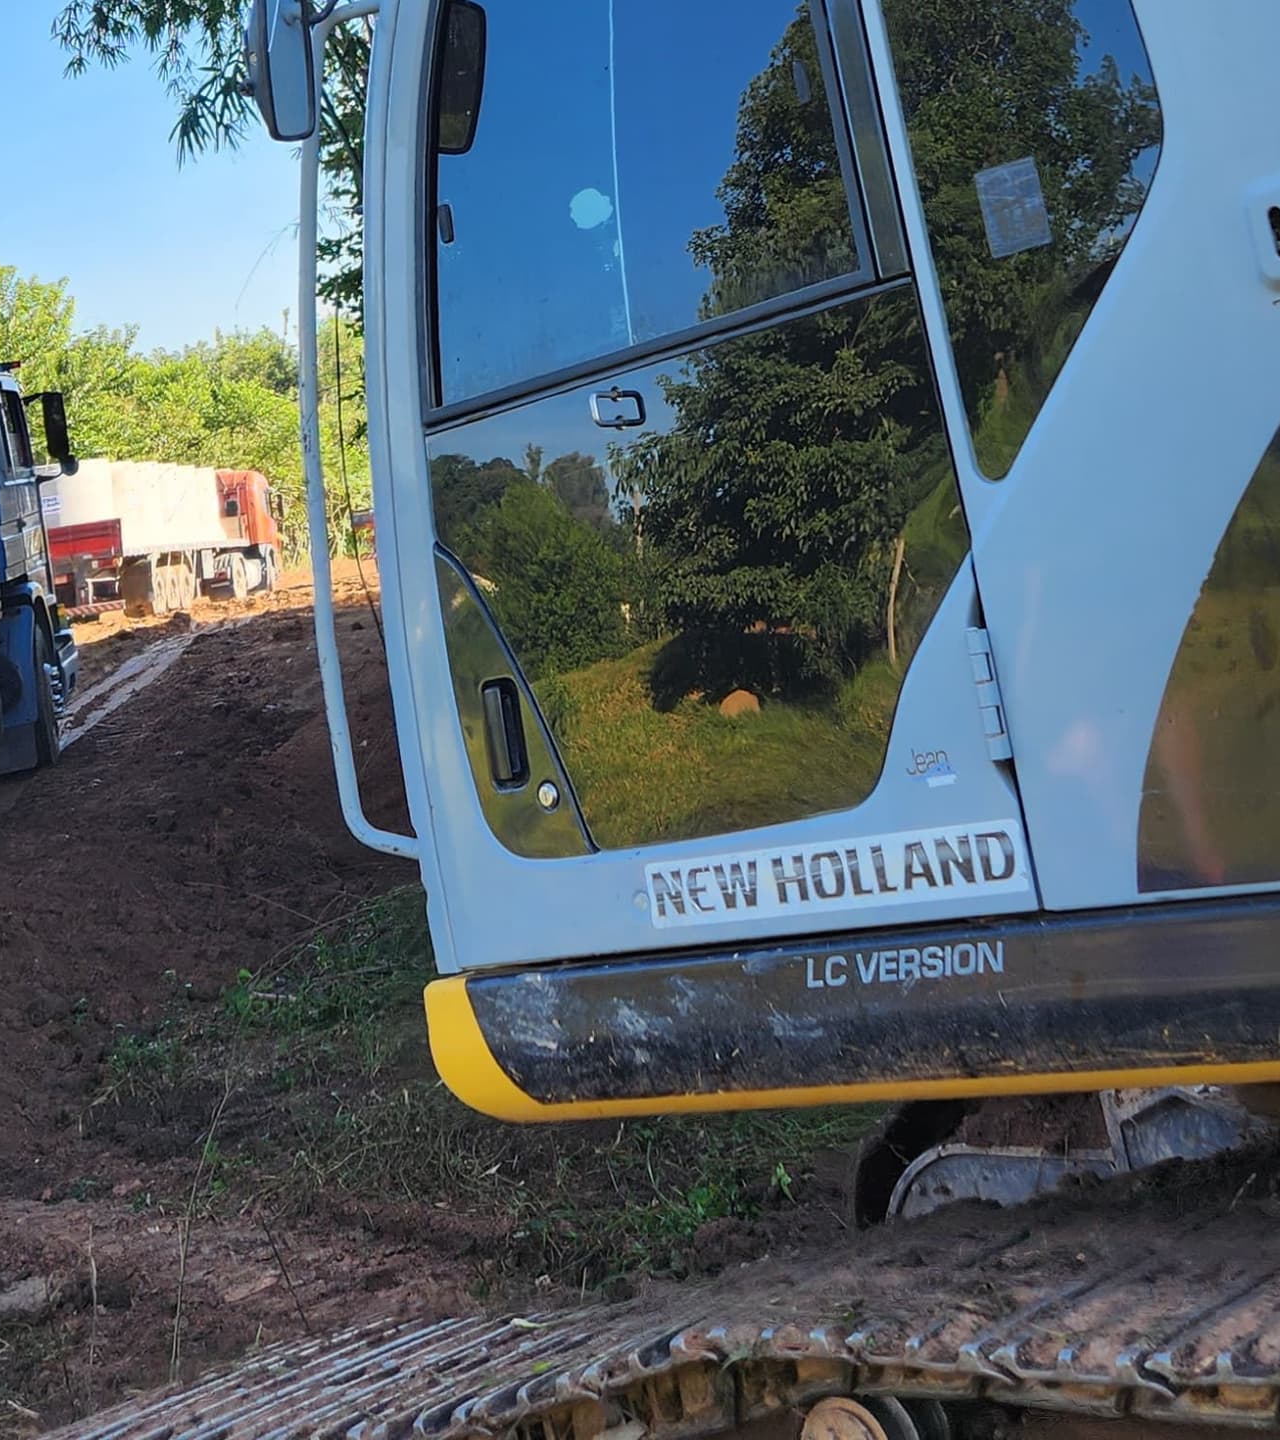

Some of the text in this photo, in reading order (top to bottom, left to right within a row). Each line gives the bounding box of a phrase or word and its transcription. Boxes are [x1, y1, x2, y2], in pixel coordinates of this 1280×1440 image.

[651, 830, 1017, 918] NEW HOLLAND
[805, 940, 1004, 989] LC VERSION
